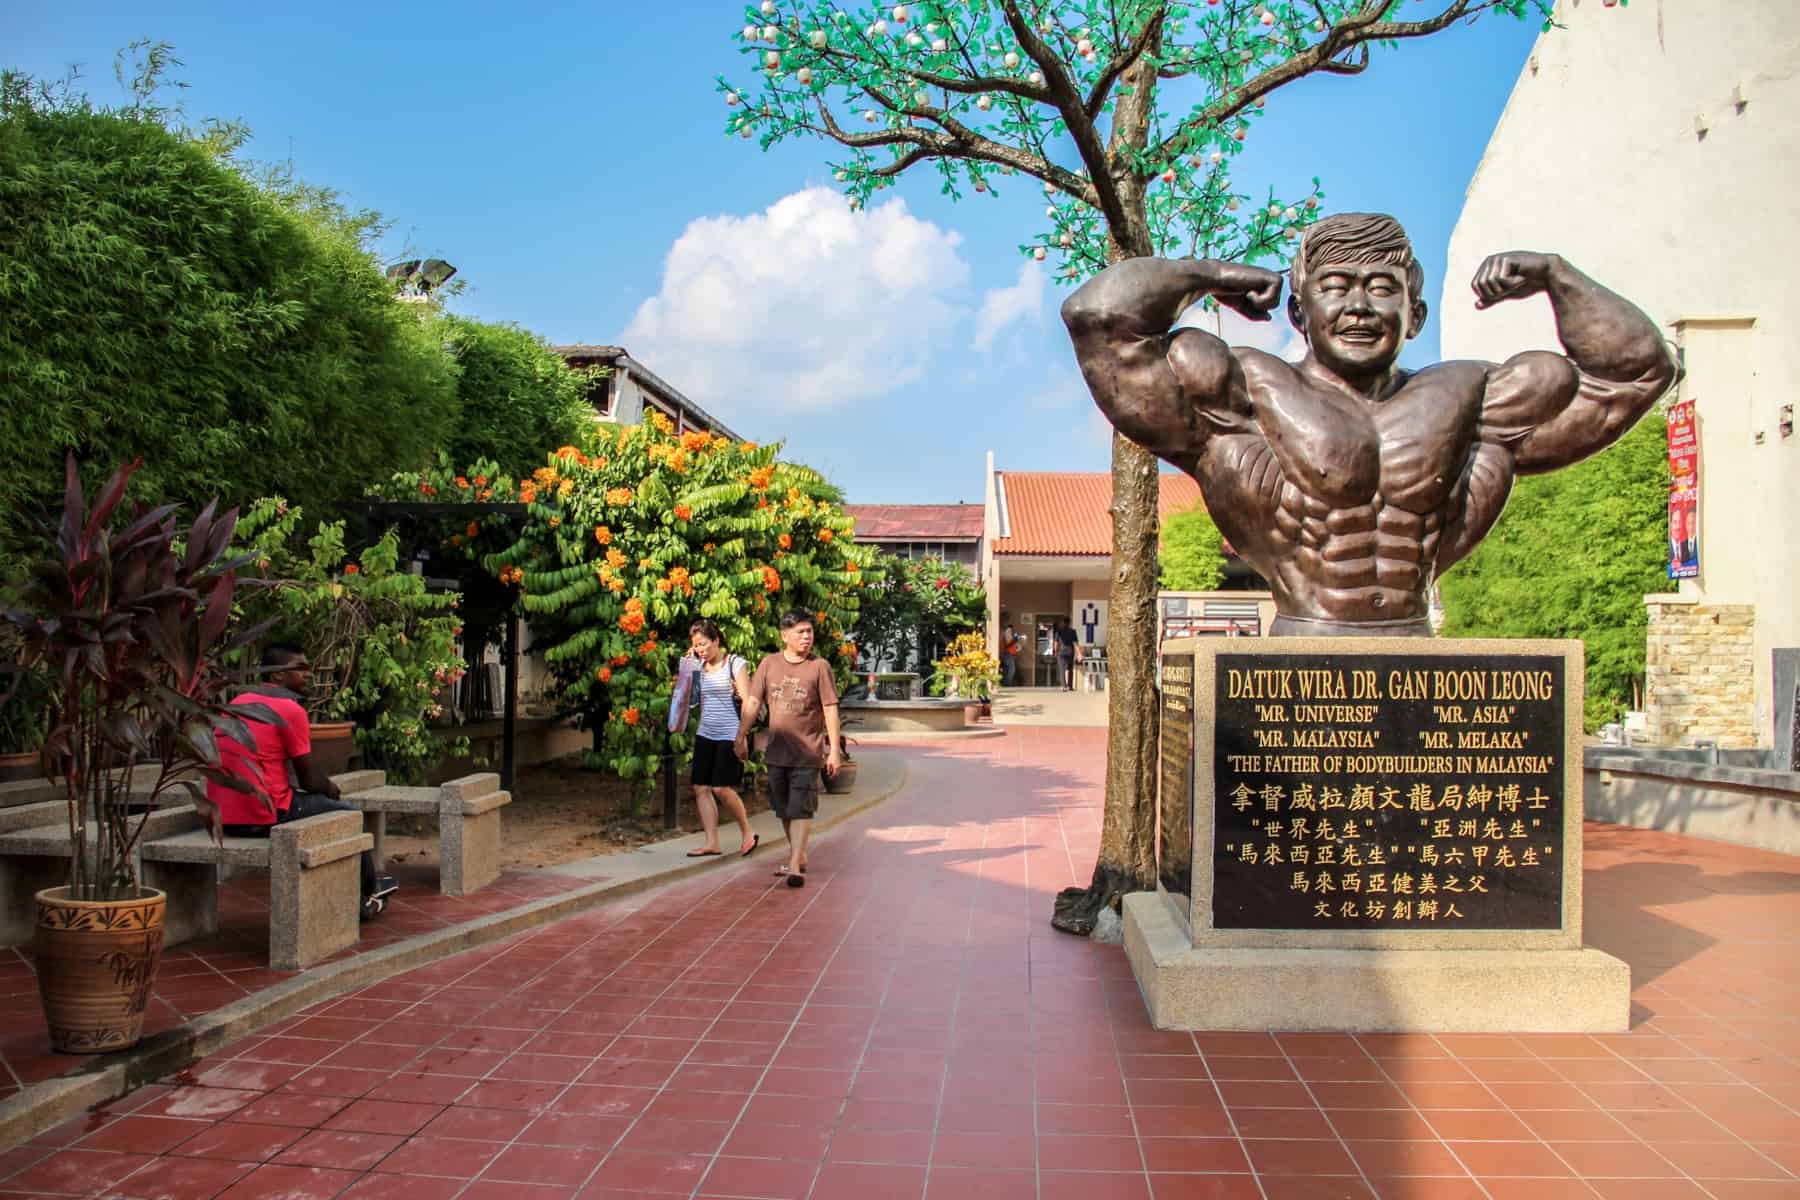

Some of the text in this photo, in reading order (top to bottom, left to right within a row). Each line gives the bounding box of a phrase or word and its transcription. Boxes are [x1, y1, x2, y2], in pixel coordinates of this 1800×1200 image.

[1229, 669, 1552, 701] DATUK WIRA DR. GAN BOON LEONG
[1255, 704, 1378, 723] "MR. UNIVERSE"
[1434, 706, 1515, 724] "MR. ASIA"
[1254, 730, 1379, 748] "MR. MALAYSIA"
[1420, 732, 1528, 749] "MR. MELAKA"
[1227, 756, 1554, 773] "THE FATHER OF BODYBUILDERS IN MALAYSIA"
[1253, 818, 1373, 840] "世界先生"
[1421, 818, 1540, 839] "亞洲先生"
[1227, 843, 1398, 866] "馬來西亞先生"
[1408, 845, 1552, 867] "馬六甲先生"
[1291, 871, 1488, 894] 馬來西亞健美之父
